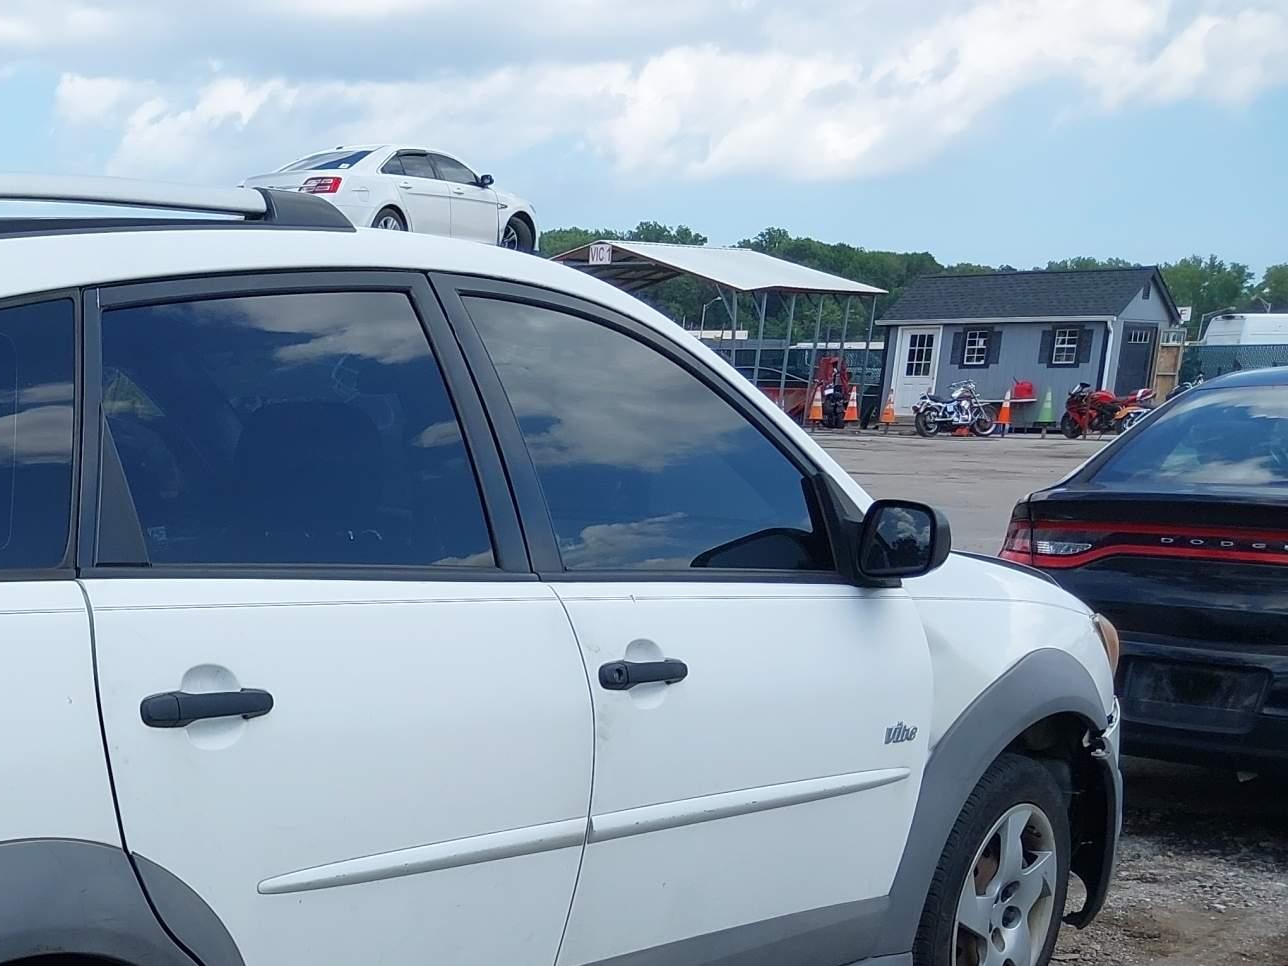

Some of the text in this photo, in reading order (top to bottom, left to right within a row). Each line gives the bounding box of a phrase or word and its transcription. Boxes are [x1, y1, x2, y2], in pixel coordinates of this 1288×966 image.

[590, 246, 611, 262] VIC 1
[1160, 537, 1288, 551] DODG
